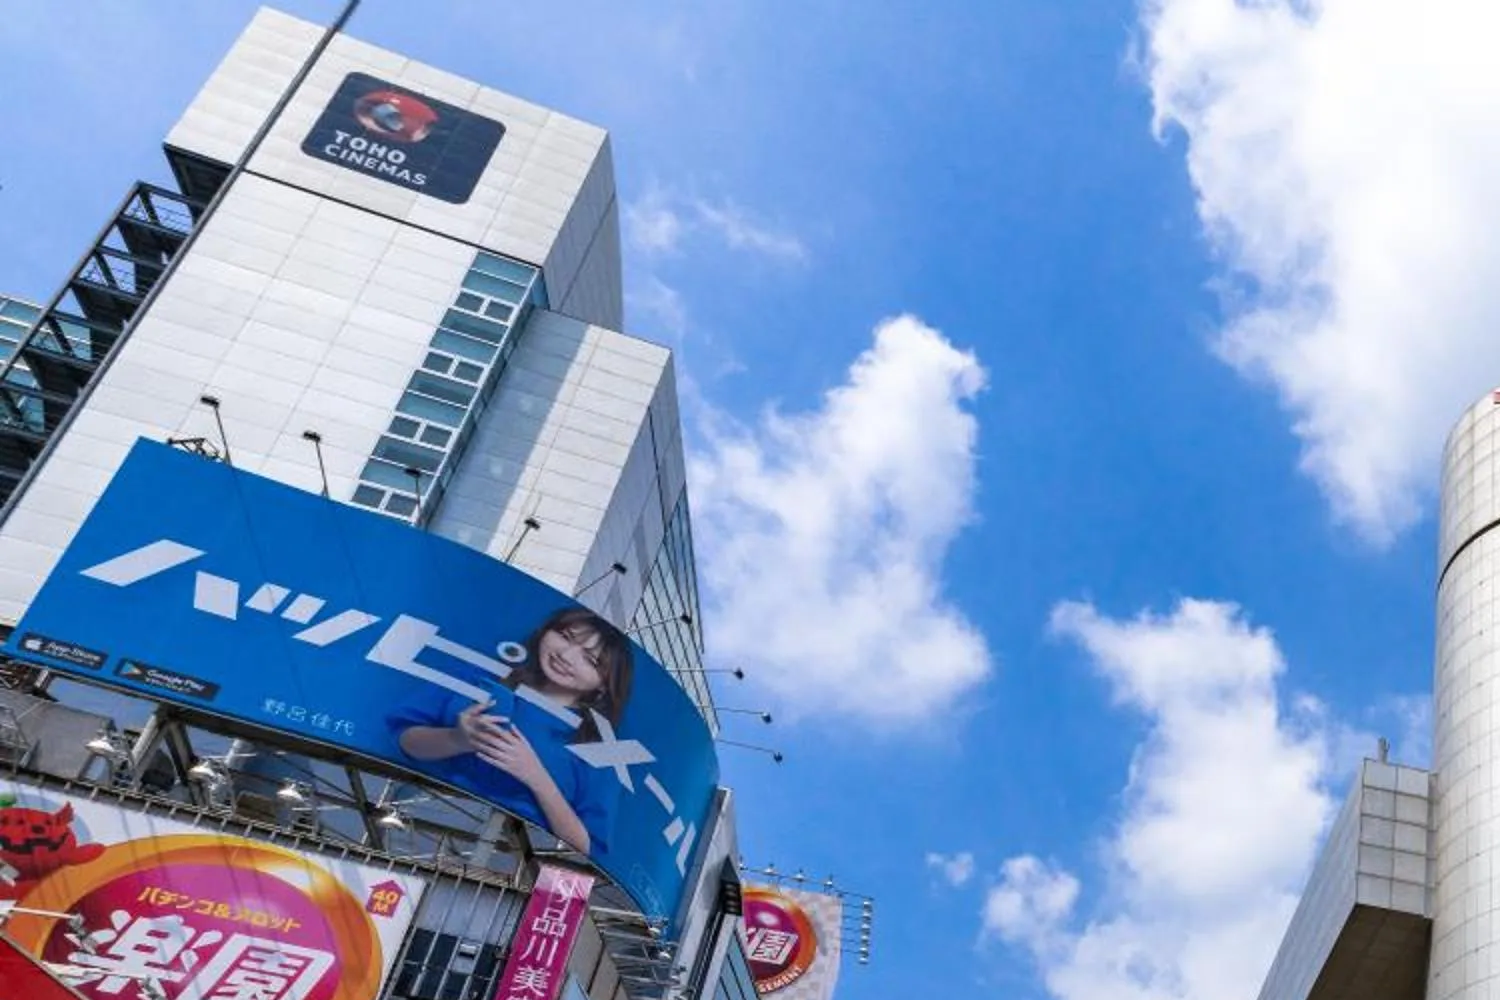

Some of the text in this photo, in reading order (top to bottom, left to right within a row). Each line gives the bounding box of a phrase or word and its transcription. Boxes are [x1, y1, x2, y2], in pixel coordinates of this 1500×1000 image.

[325, 143, 427, 186] CINEMAS
[334, 130, 406, 163] TOHO
[138, 886, 301, 932] パチンコ&スロット
[371, 890, 398, 904] 40
